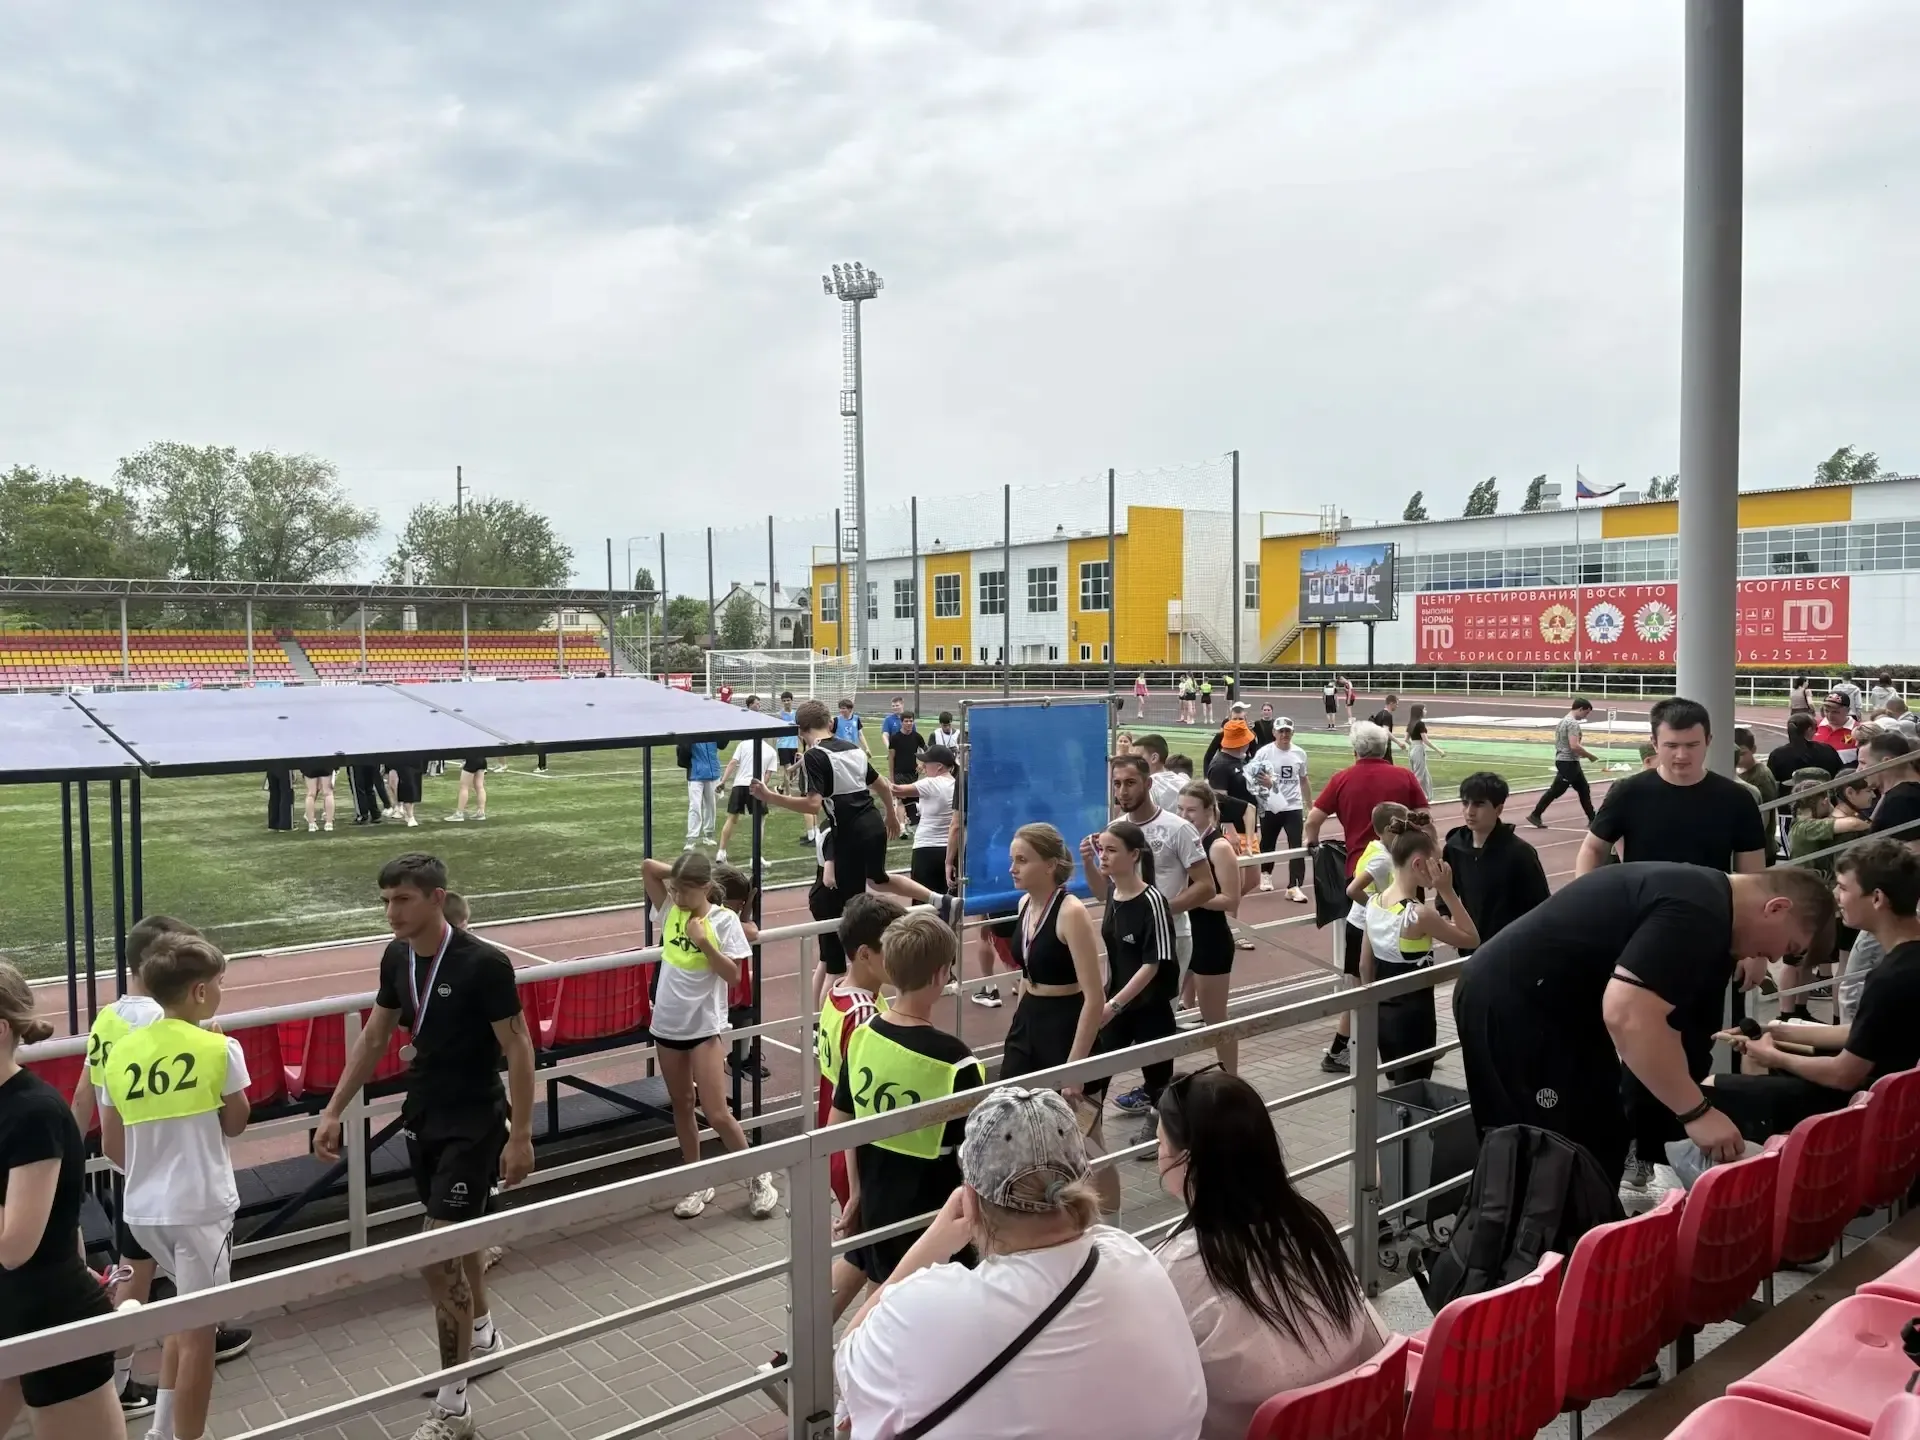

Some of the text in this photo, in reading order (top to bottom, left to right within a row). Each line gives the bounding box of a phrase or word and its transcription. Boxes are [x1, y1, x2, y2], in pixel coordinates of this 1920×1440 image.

[1421, 595, 1461, 606] ЦЕНТР
[1468, 589, 1577, 603] ТЕСТИРОВАНИЯ
[1586, 588, 1626, 599] ВФСК
[1636, 586, 1666, 597] ГТО
[1421, 607, 1454, 615] ВЫПОЛНИ
[1421, 615, 1454, 624] НОРМЫ
[1783, 598, 1833, 631] ГТО
[1421, 624, 1454, 649] ГТО
[1428, 652, 1444, 661] СК
[1658, 650, 1665, 660] 8
[1750, 649, 1828, 661] 6-25-12
[124, 1052, 198, 1101] 262
